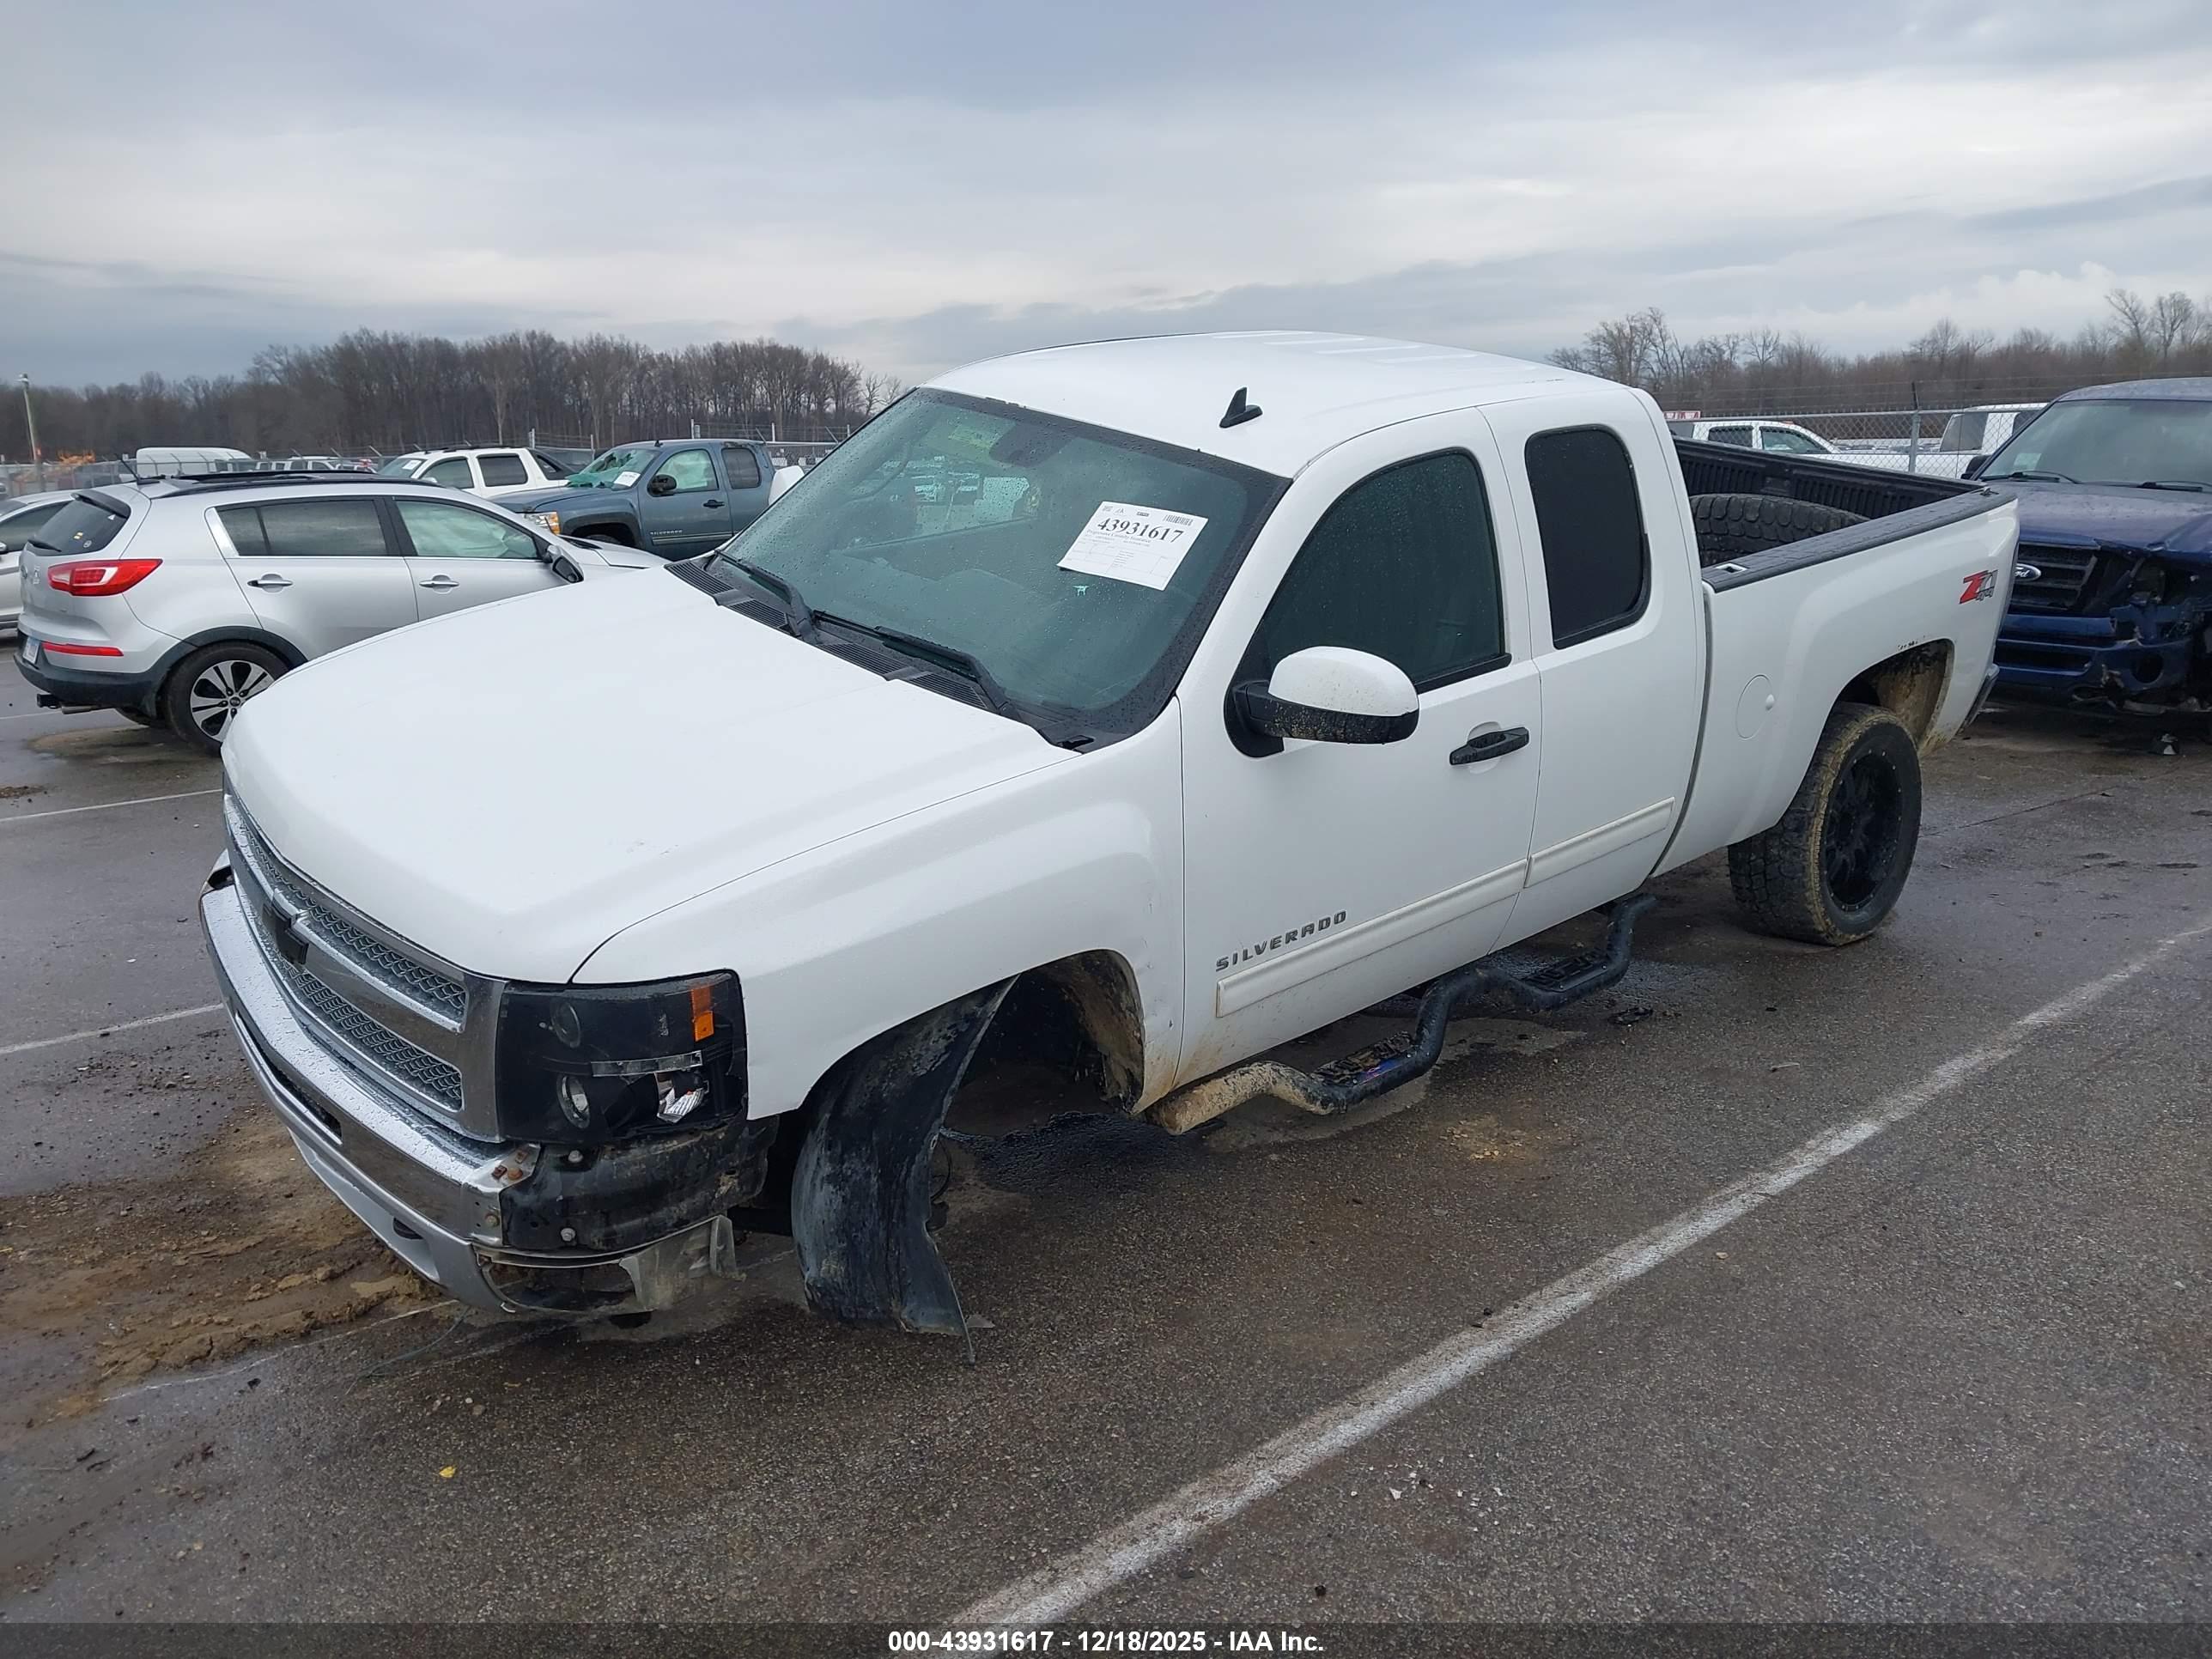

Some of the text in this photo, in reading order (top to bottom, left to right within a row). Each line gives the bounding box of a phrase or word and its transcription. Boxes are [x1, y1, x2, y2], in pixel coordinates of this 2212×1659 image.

[1097, 518, 1184, 543] 43931617
[1960, 569, 1998, 604] Z71
[1215, 910, 1346, 972] SILVERADO
